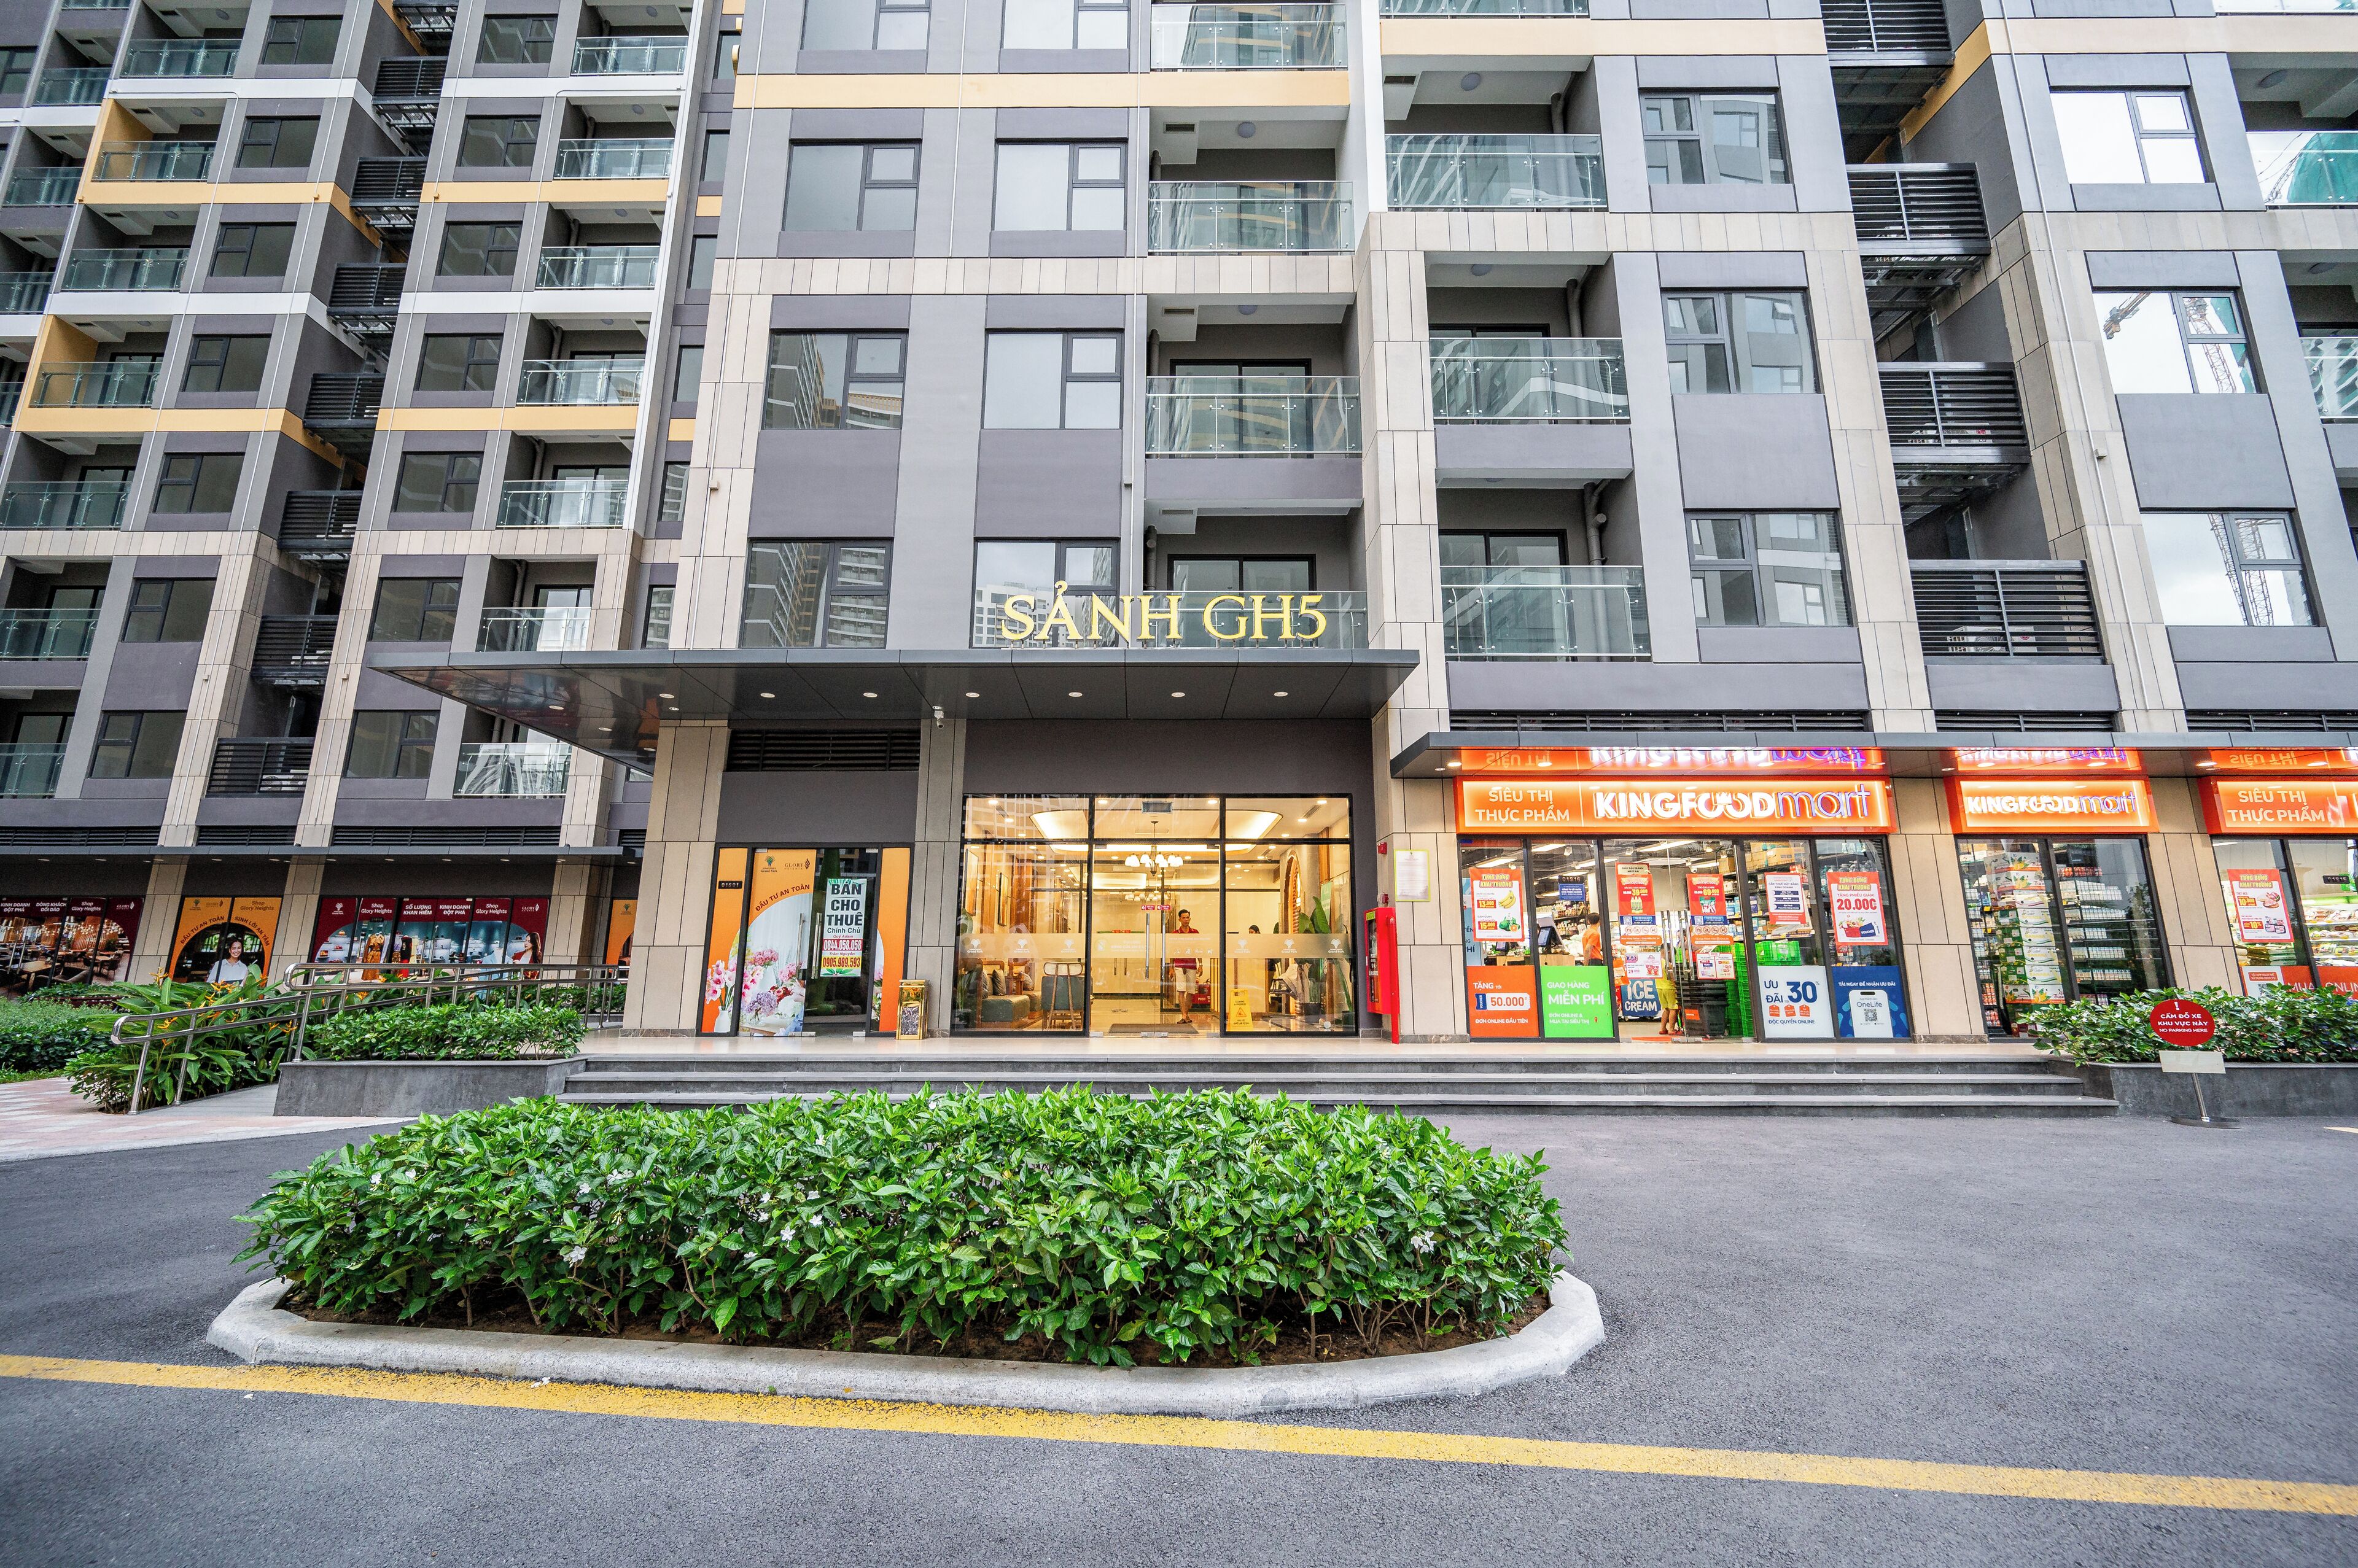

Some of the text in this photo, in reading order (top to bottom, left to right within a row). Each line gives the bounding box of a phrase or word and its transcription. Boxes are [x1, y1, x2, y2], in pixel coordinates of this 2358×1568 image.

[1001, 580, 1327, 642] SẢNH GH5
[1488, 786, 1554, 807] SIÊU THỊ
[2238, 788, 2307, 805] SIÊU THỊ
[1474, 803, 1570, 824] THỰC PHẨM
[2227, 806, 2325, 825] THỰC PHẨM
[831, 881, 862, 895] BÁN
[755, 883, 810, 912] ĐẦU TƯ AN TOÀN
[830, 899, 860, 911] CHO
[827, 912, 863, 926] THUÊ
[823, 940, 862, 950] 0844.058.058
[823, 957, 860, 968] 0905.989.593
[1473, 980, 1493, 990] TẶNG
[1567, 980, 1590, 988] HÀNG
[1764, 980, 1778, 988] ƯU
[1548, 990, 1605, 1004] MIỄN PHÍ
[1765, 993, 1783, 1003] ĐÃI
[1625, 1001, 1657, 1012] CREAM
